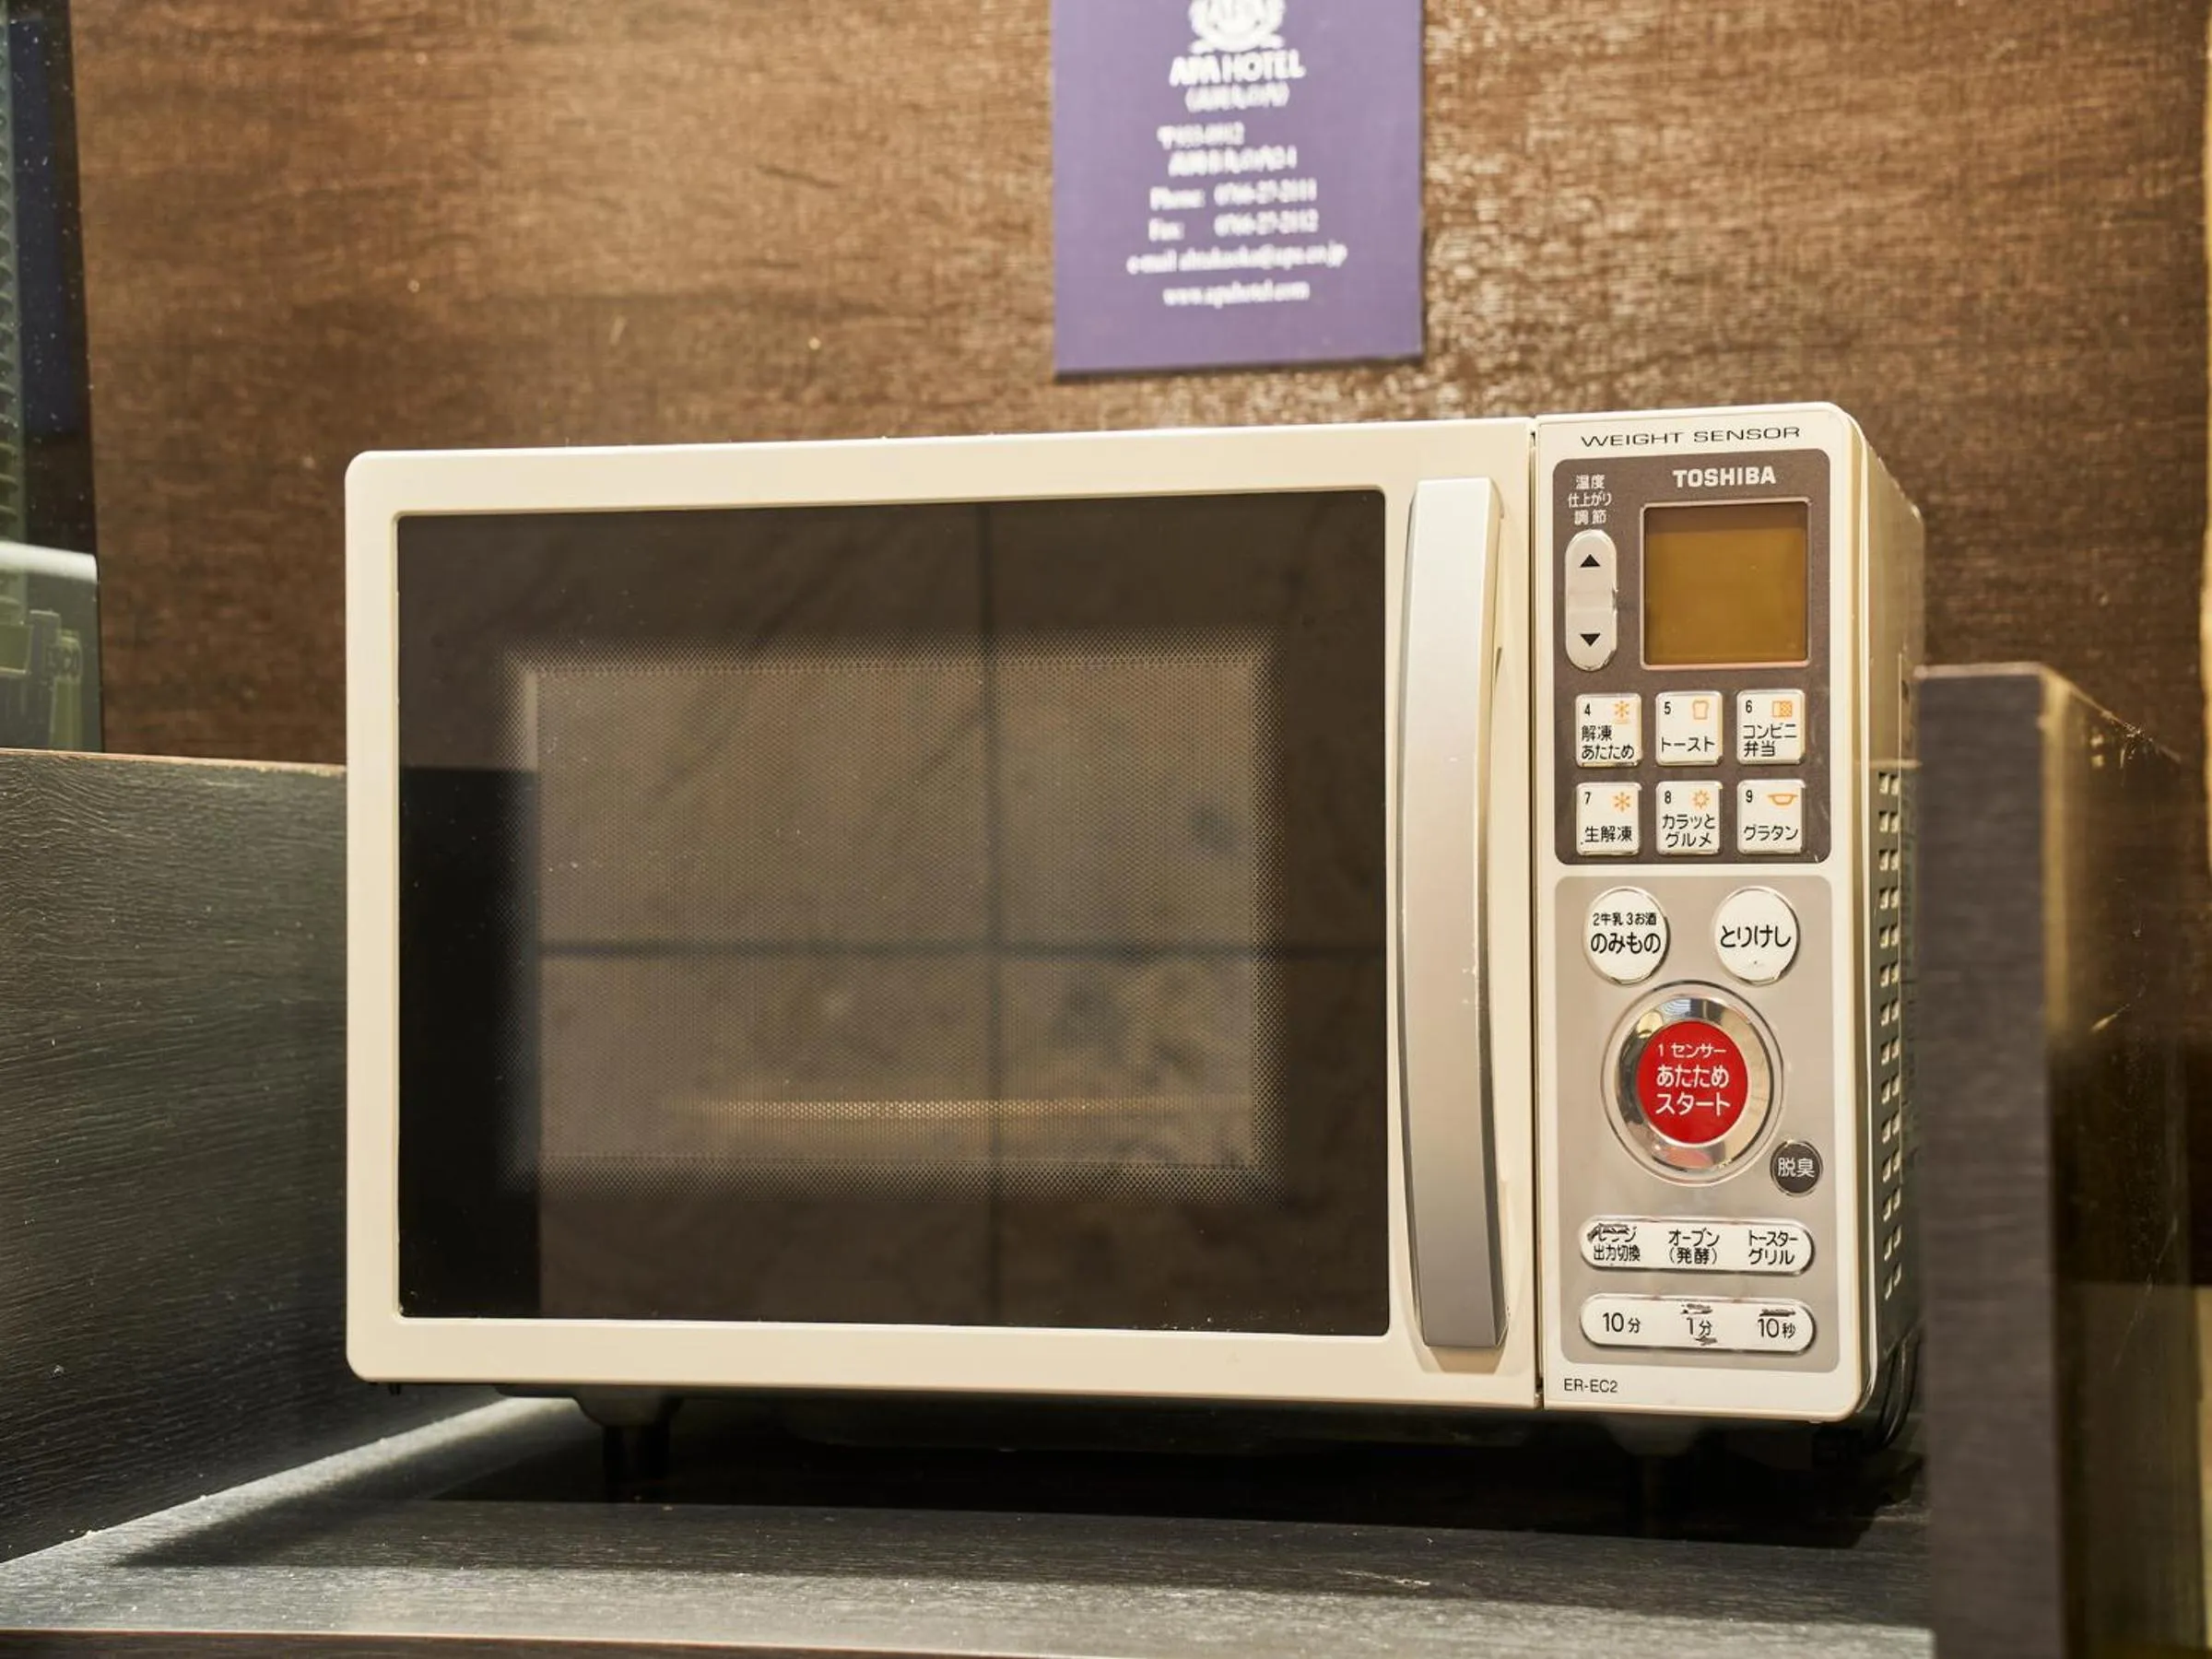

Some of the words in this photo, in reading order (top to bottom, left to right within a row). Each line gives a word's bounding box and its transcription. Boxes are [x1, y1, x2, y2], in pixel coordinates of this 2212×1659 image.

[1222, 49, 1306, 81] HOTEL
[1582, 431, 1683, 447] WEIGHT
[1694, 427, 1800, 443] SENSOR
[1576, 474, 1606, 489] 温度
[1673, 465, 1776, 488] TOSHIBA
[1568, 490, 1612, 508] 仕上がり
[1584, 703, 1591, 716] 4
[1664, 701, 1671, 715] 5
[1745, 700, 1752, 713] 6
[1582, 725, 1612, 741] 解凍
[1743, 723, 1796, 739] コンビニ
[1582, 744, 1634, 760] あたため
[1661, 736, 1715, 753] トースト
[1744, 741, 1776, 758] 弁当
[1584, 792, 1591, 805] 7
[1664, 791, 1671, 804] 8
[1746, 790, 1753, 803] 9
[1662, 814, 1715, 830] カラッと
[1584, 826, 1632, 843] 生解凍
[1665, 832, 1712, 848] グルメ
[1744, 825, 1798, 841] グラタン
[1590, 932, 1661, 954] のみもの
[1720, 924, 1792, 947] とりけし
[1671, 1043, 1726, 1058] センサー
[1656, 1065, 1729, 1088] あたため
[1655, 1092, 1731, 1117] スタート
[1777, 1158, 1815, 1178] 脱臭
[1668, 1228, 1720, 1246] オーブン
[1748, 1230, 1798, 1246] トースター
[1593, 1244, 1641, 1262] 出力切換
[1748, 1248, 1795, 1265] グリル
[1563, 1378, 1618, 1394] ER-EC2
